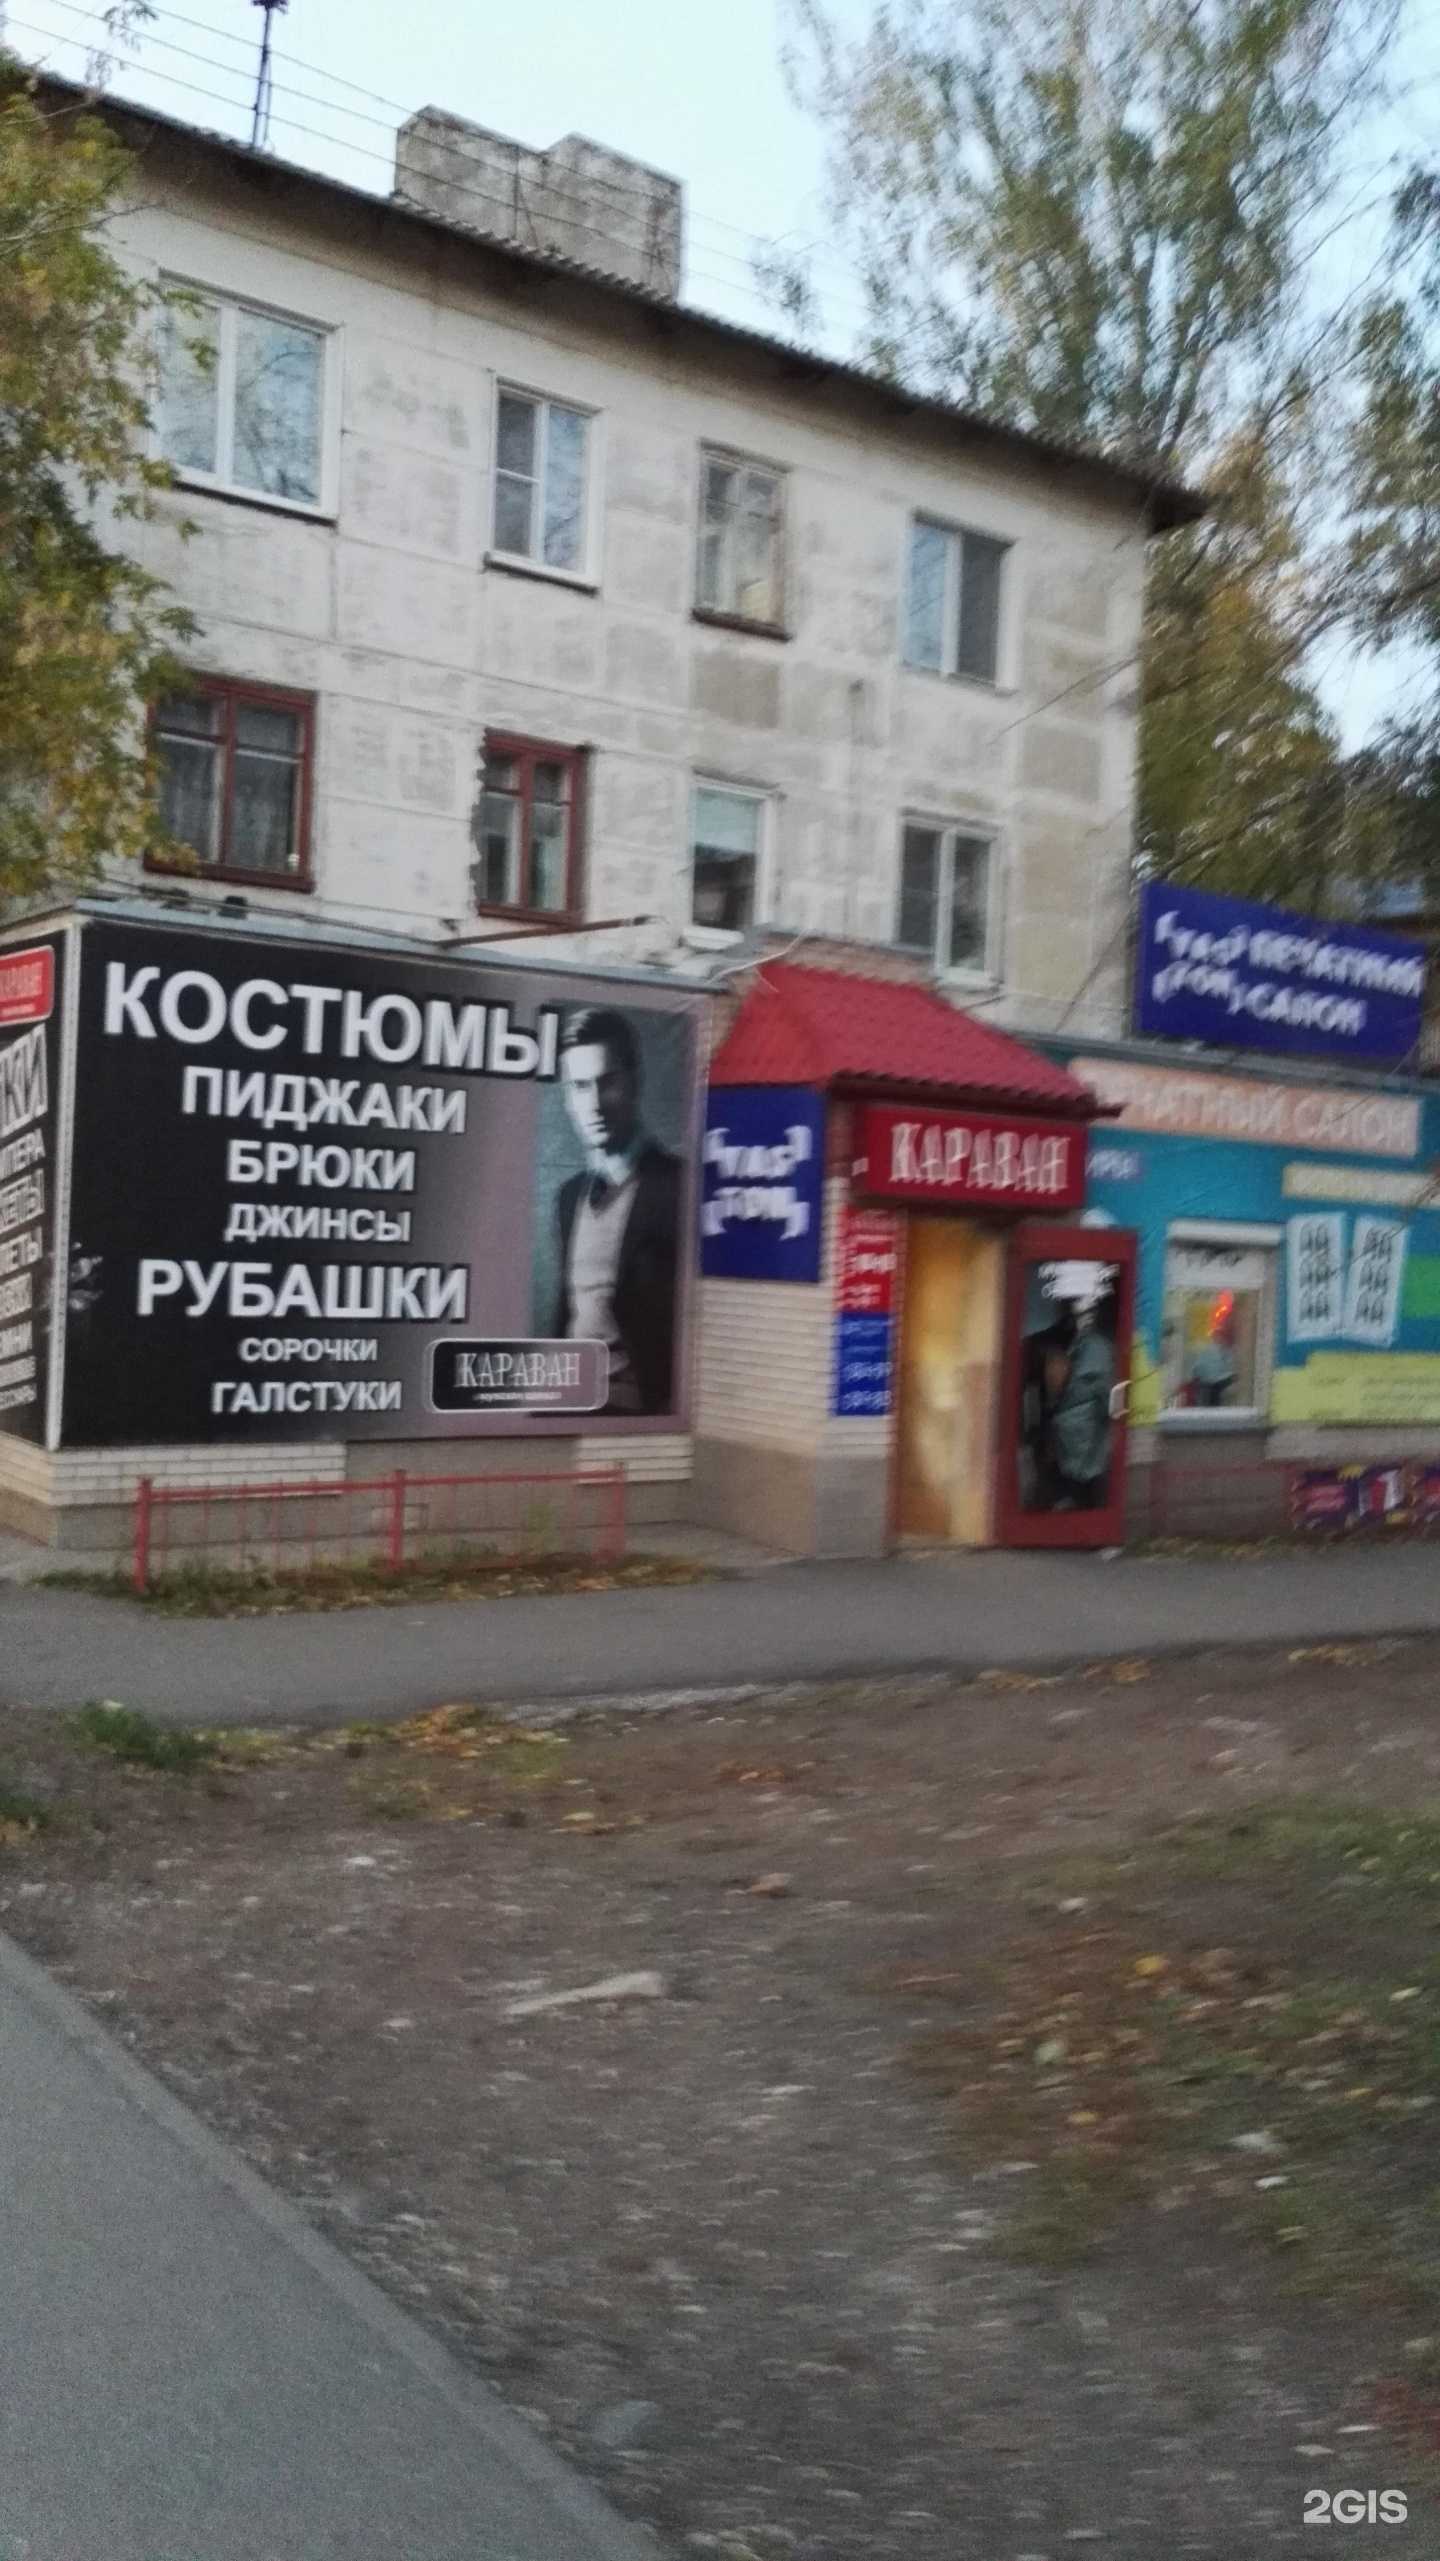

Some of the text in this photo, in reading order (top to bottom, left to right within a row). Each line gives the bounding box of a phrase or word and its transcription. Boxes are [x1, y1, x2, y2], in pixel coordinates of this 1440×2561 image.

[103, 961, 558, 1077] КОСТЮМЫ
[0, 1023, 48, 1136] КИ
[182, 1066, 468, 1134] ПИДЖАКИ
[226, 1140, 417, 1192] БРЮКИ
[888, 1121, 1072, 1194] КАРАВАН
[224, 1203, 412, 1243] ДЖИНСЫ
[137, 1260, 470, 1322] РУБАШКИ
[238, 1337, 379, 1363] СОРОЧКИ
[454, 1352, 581, 1388] КАРАВАН
[210, 1380, 403, 1414] ГАЛСТУКИ
